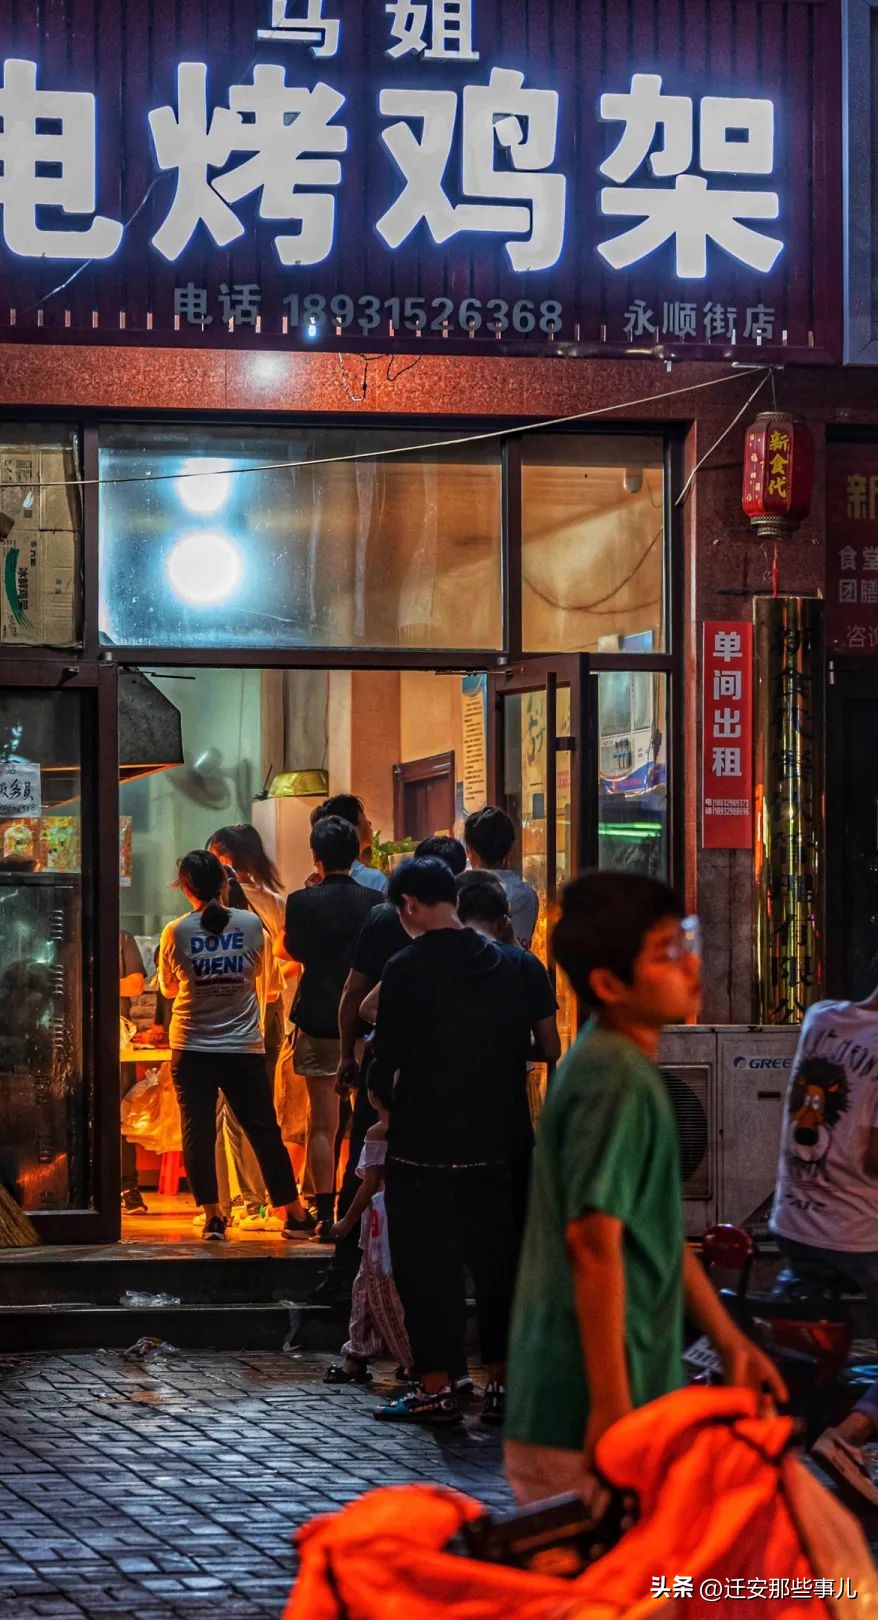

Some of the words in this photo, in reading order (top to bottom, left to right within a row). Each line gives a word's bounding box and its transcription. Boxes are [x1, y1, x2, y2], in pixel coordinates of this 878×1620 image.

[173, 282, 262, 326] 电话
[282, 292, 563, 334] 18931526368
[623, 299, 775, 340] 永顺街店
[769, 431, 790, 498] 新食代
[712, 631, 743, 777] 单间出租
[190, 932, 245, 954] DOVE
[191, 955, 244, 977] VIENI
[748, 1057, 793, 1069] GREE
